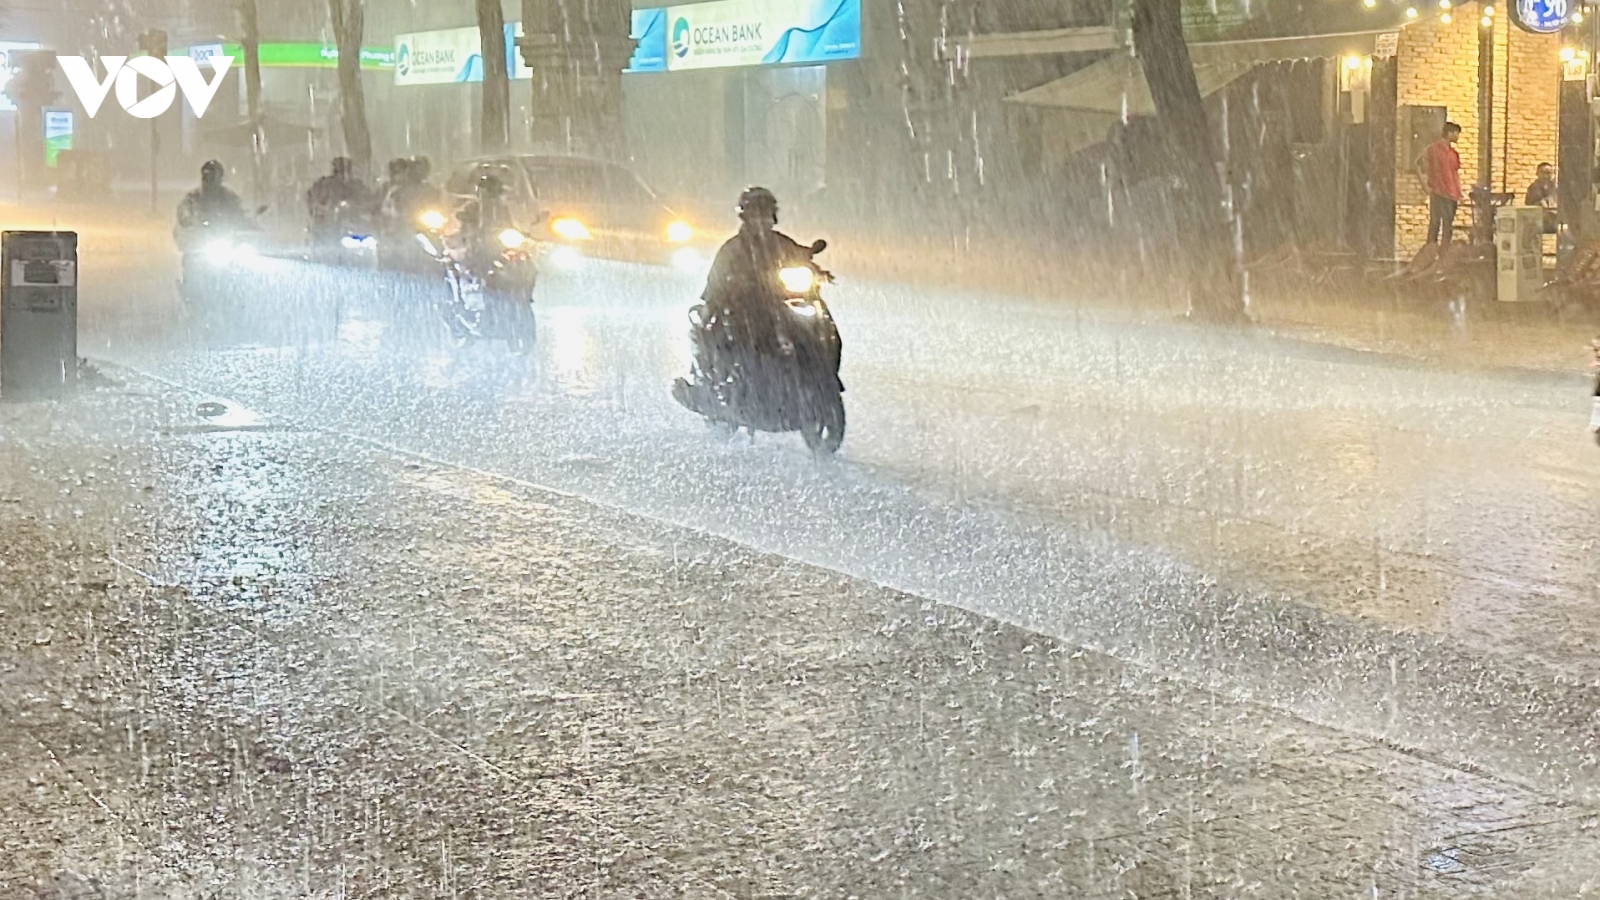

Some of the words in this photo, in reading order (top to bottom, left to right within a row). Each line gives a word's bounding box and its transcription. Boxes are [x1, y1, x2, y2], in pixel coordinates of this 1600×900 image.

[693, 27, 729, 45] OCEAN
[732, 22, 762, 42] BANK
[411, 51, 434, 66] OCEAN
[435, 49, 455, 64] BANK
